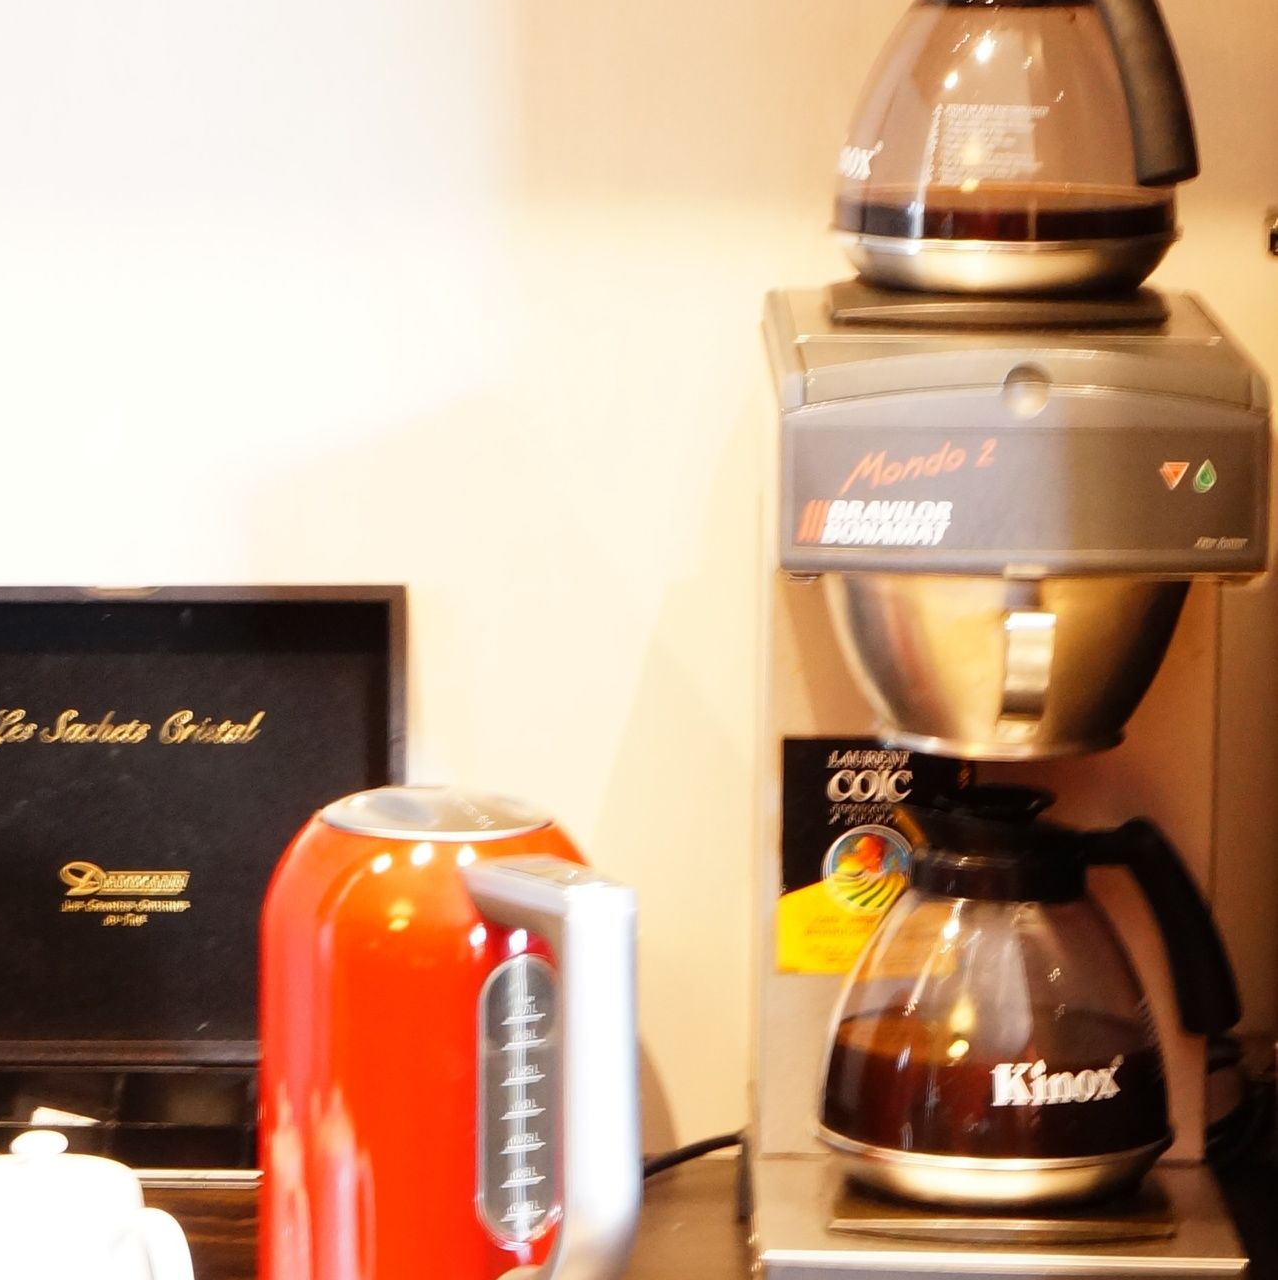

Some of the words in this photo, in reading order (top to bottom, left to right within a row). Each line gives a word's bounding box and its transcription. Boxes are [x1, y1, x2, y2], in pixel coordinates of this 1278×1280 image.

[838, 440, 968, 496] Mondo
[974, 437, 998, 468] 2
[990, 1059, 1121, 1107] Kinox
